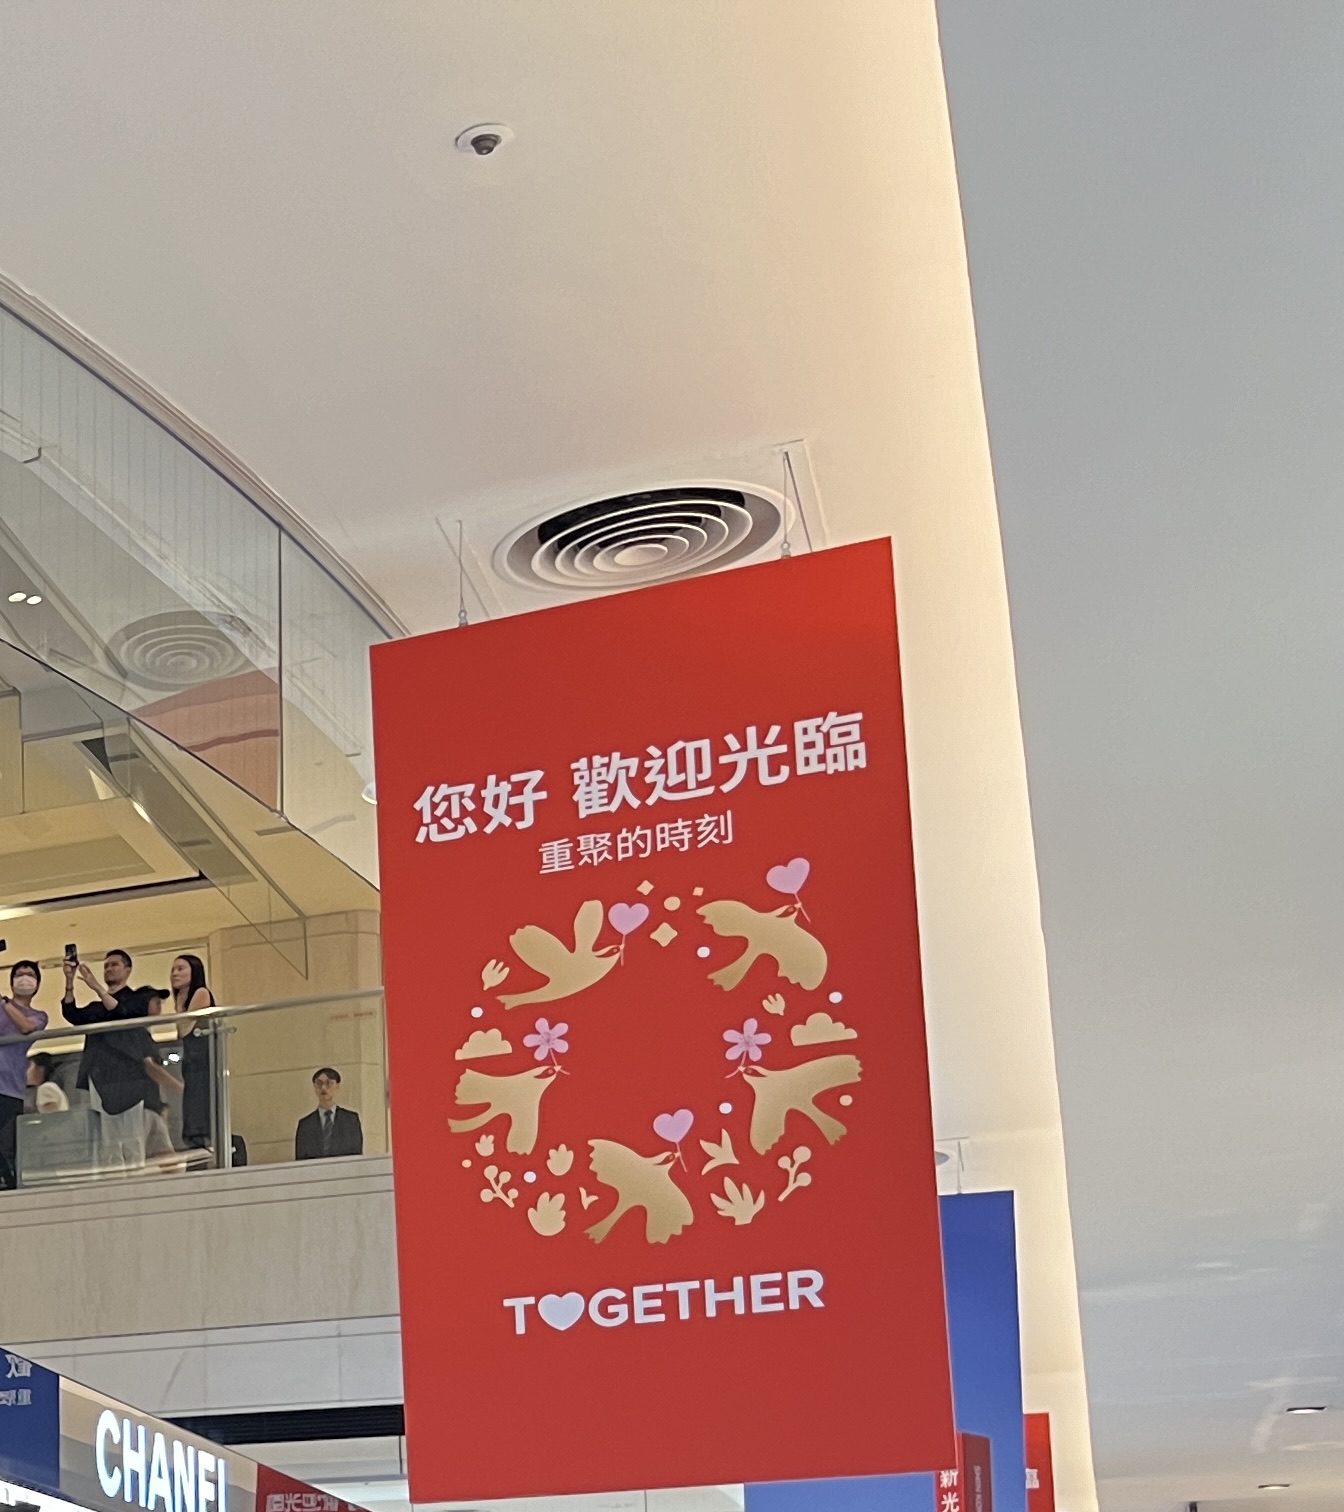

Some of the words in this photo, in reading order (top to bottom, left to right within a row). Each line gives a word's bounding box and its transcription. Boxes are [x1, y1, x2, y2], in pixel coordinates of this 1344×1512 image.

[413, 769, 548, 844] 您好
[570, 711, 868, 818] 歡迎光臨
[538, 810, 734, 875] 重聚的時刻
